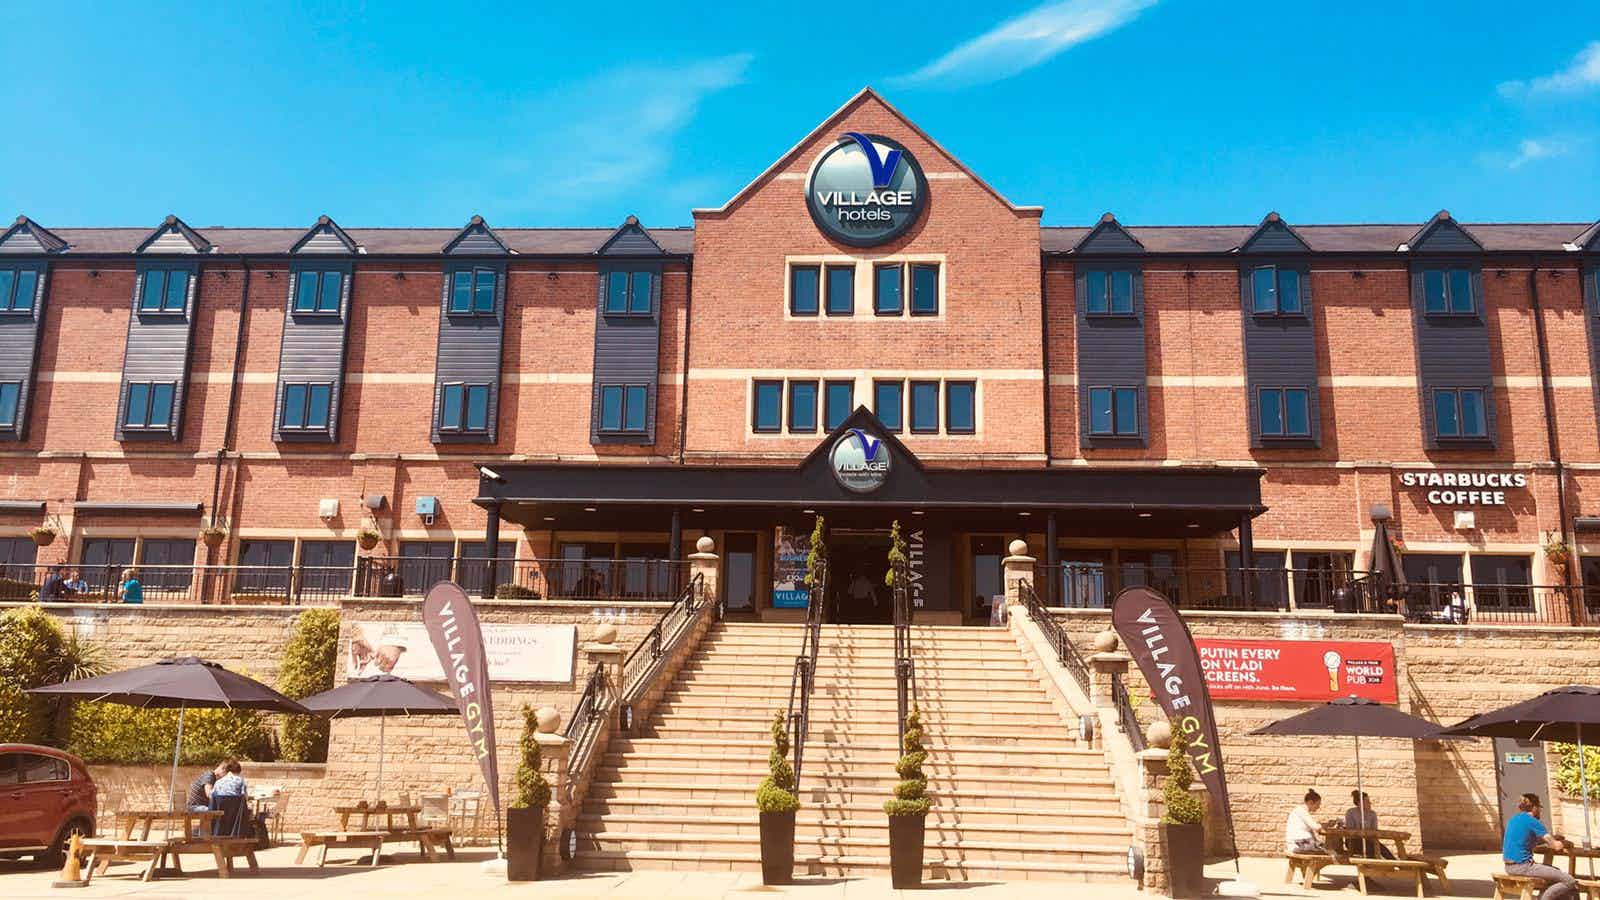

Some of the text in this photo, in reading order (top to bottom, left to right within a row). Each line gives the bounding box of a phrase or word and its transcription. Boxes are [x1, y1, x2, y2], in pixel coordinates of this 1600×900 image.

[817, 191, 912, 206] VILLAGE
[838, 208, 891, 221] hotels
[1403, 472, 1526, 487] STARBUCKS
[1428, 491, 1505, 505] COFFEE
[775, 592, 809, 601] VILLAG
[1201, 648, 1280, 660] PUTIN EVERY
[1201, 660, 1263, 671] ON VLADI
[1346, 666, 1383, 676] WORLD
[439, 600, 489, 760] VILLAGE GYM
[1347, 675, 1366, 684] PUB
[1136, 608, 1218, 774] VILLAGE GYM
